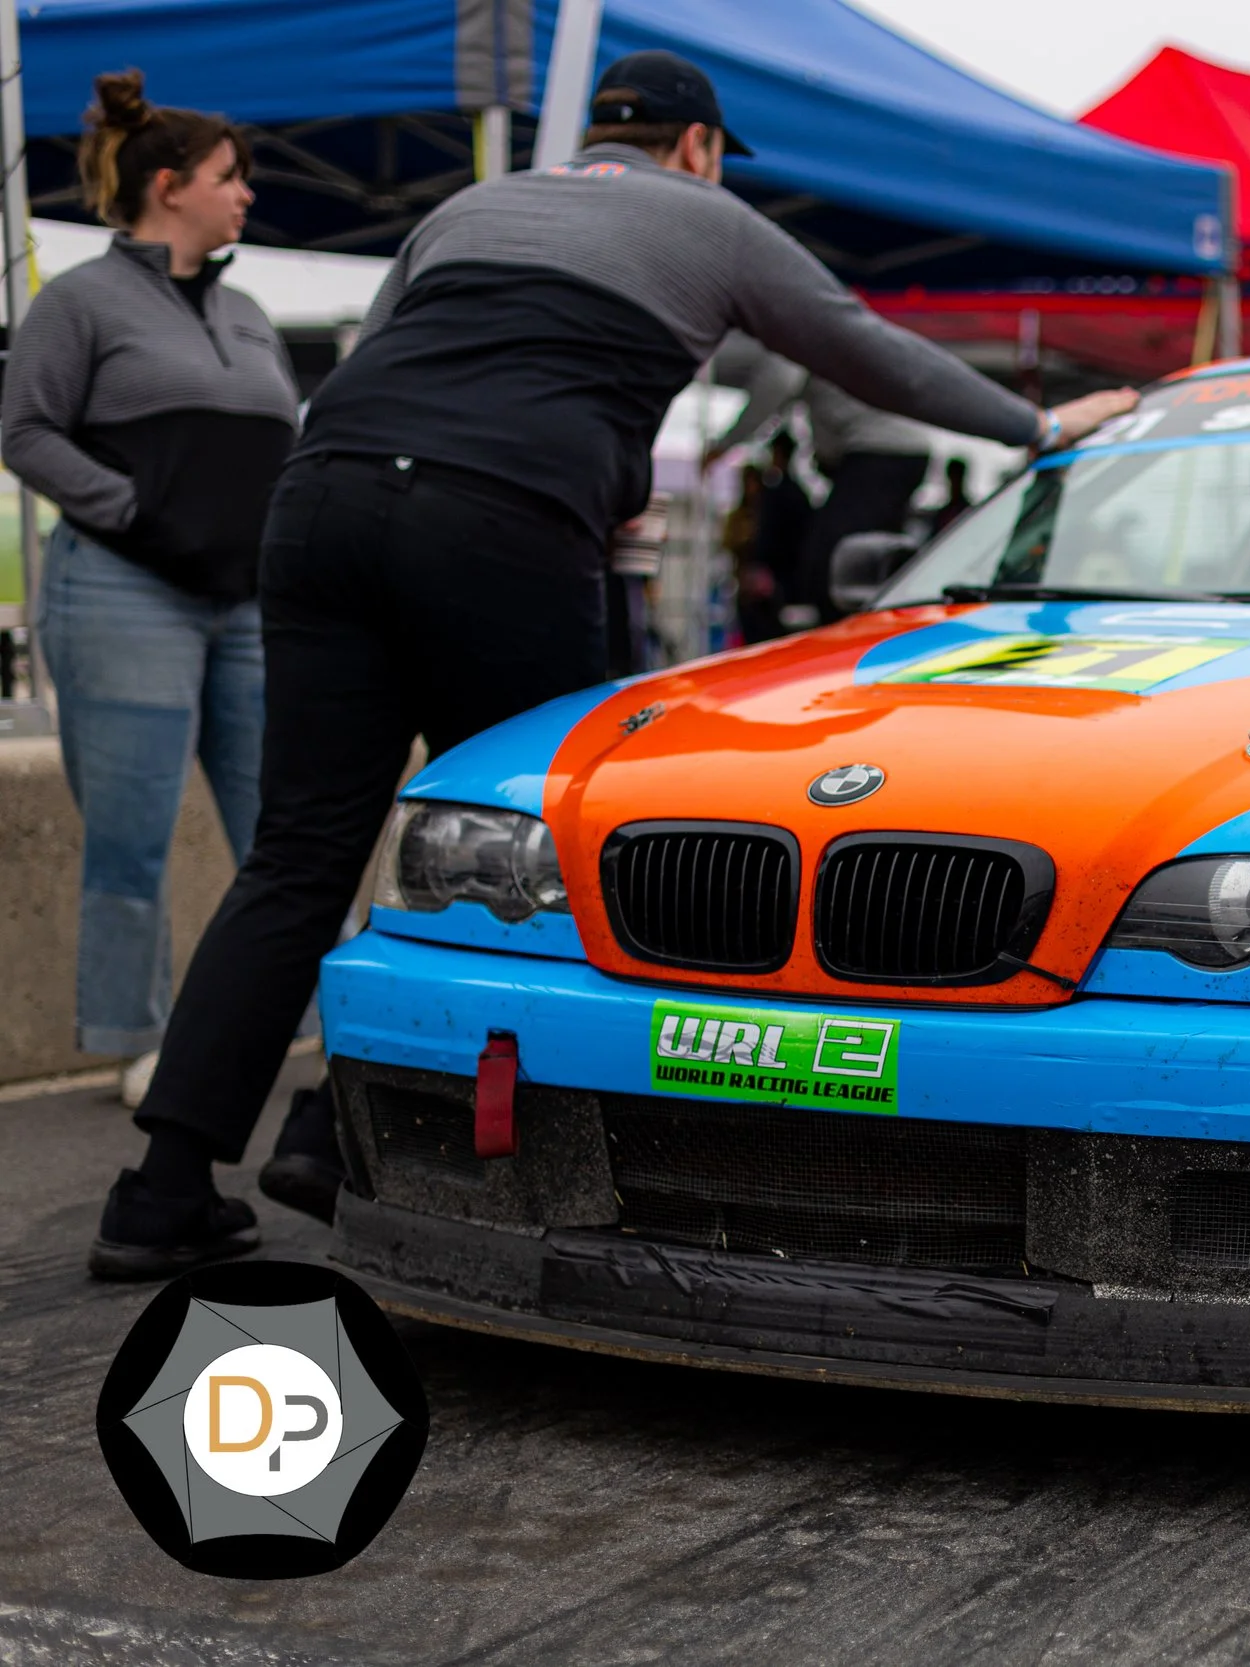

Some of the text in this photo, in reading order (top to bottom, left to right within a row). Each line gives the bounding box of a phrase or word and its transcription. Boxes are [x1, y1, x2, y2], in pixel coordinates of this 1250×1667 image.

[656, 1014, 787, 1070] WRL
[656, 1063, 894, 1103] WORLD RACING LEAGUE
